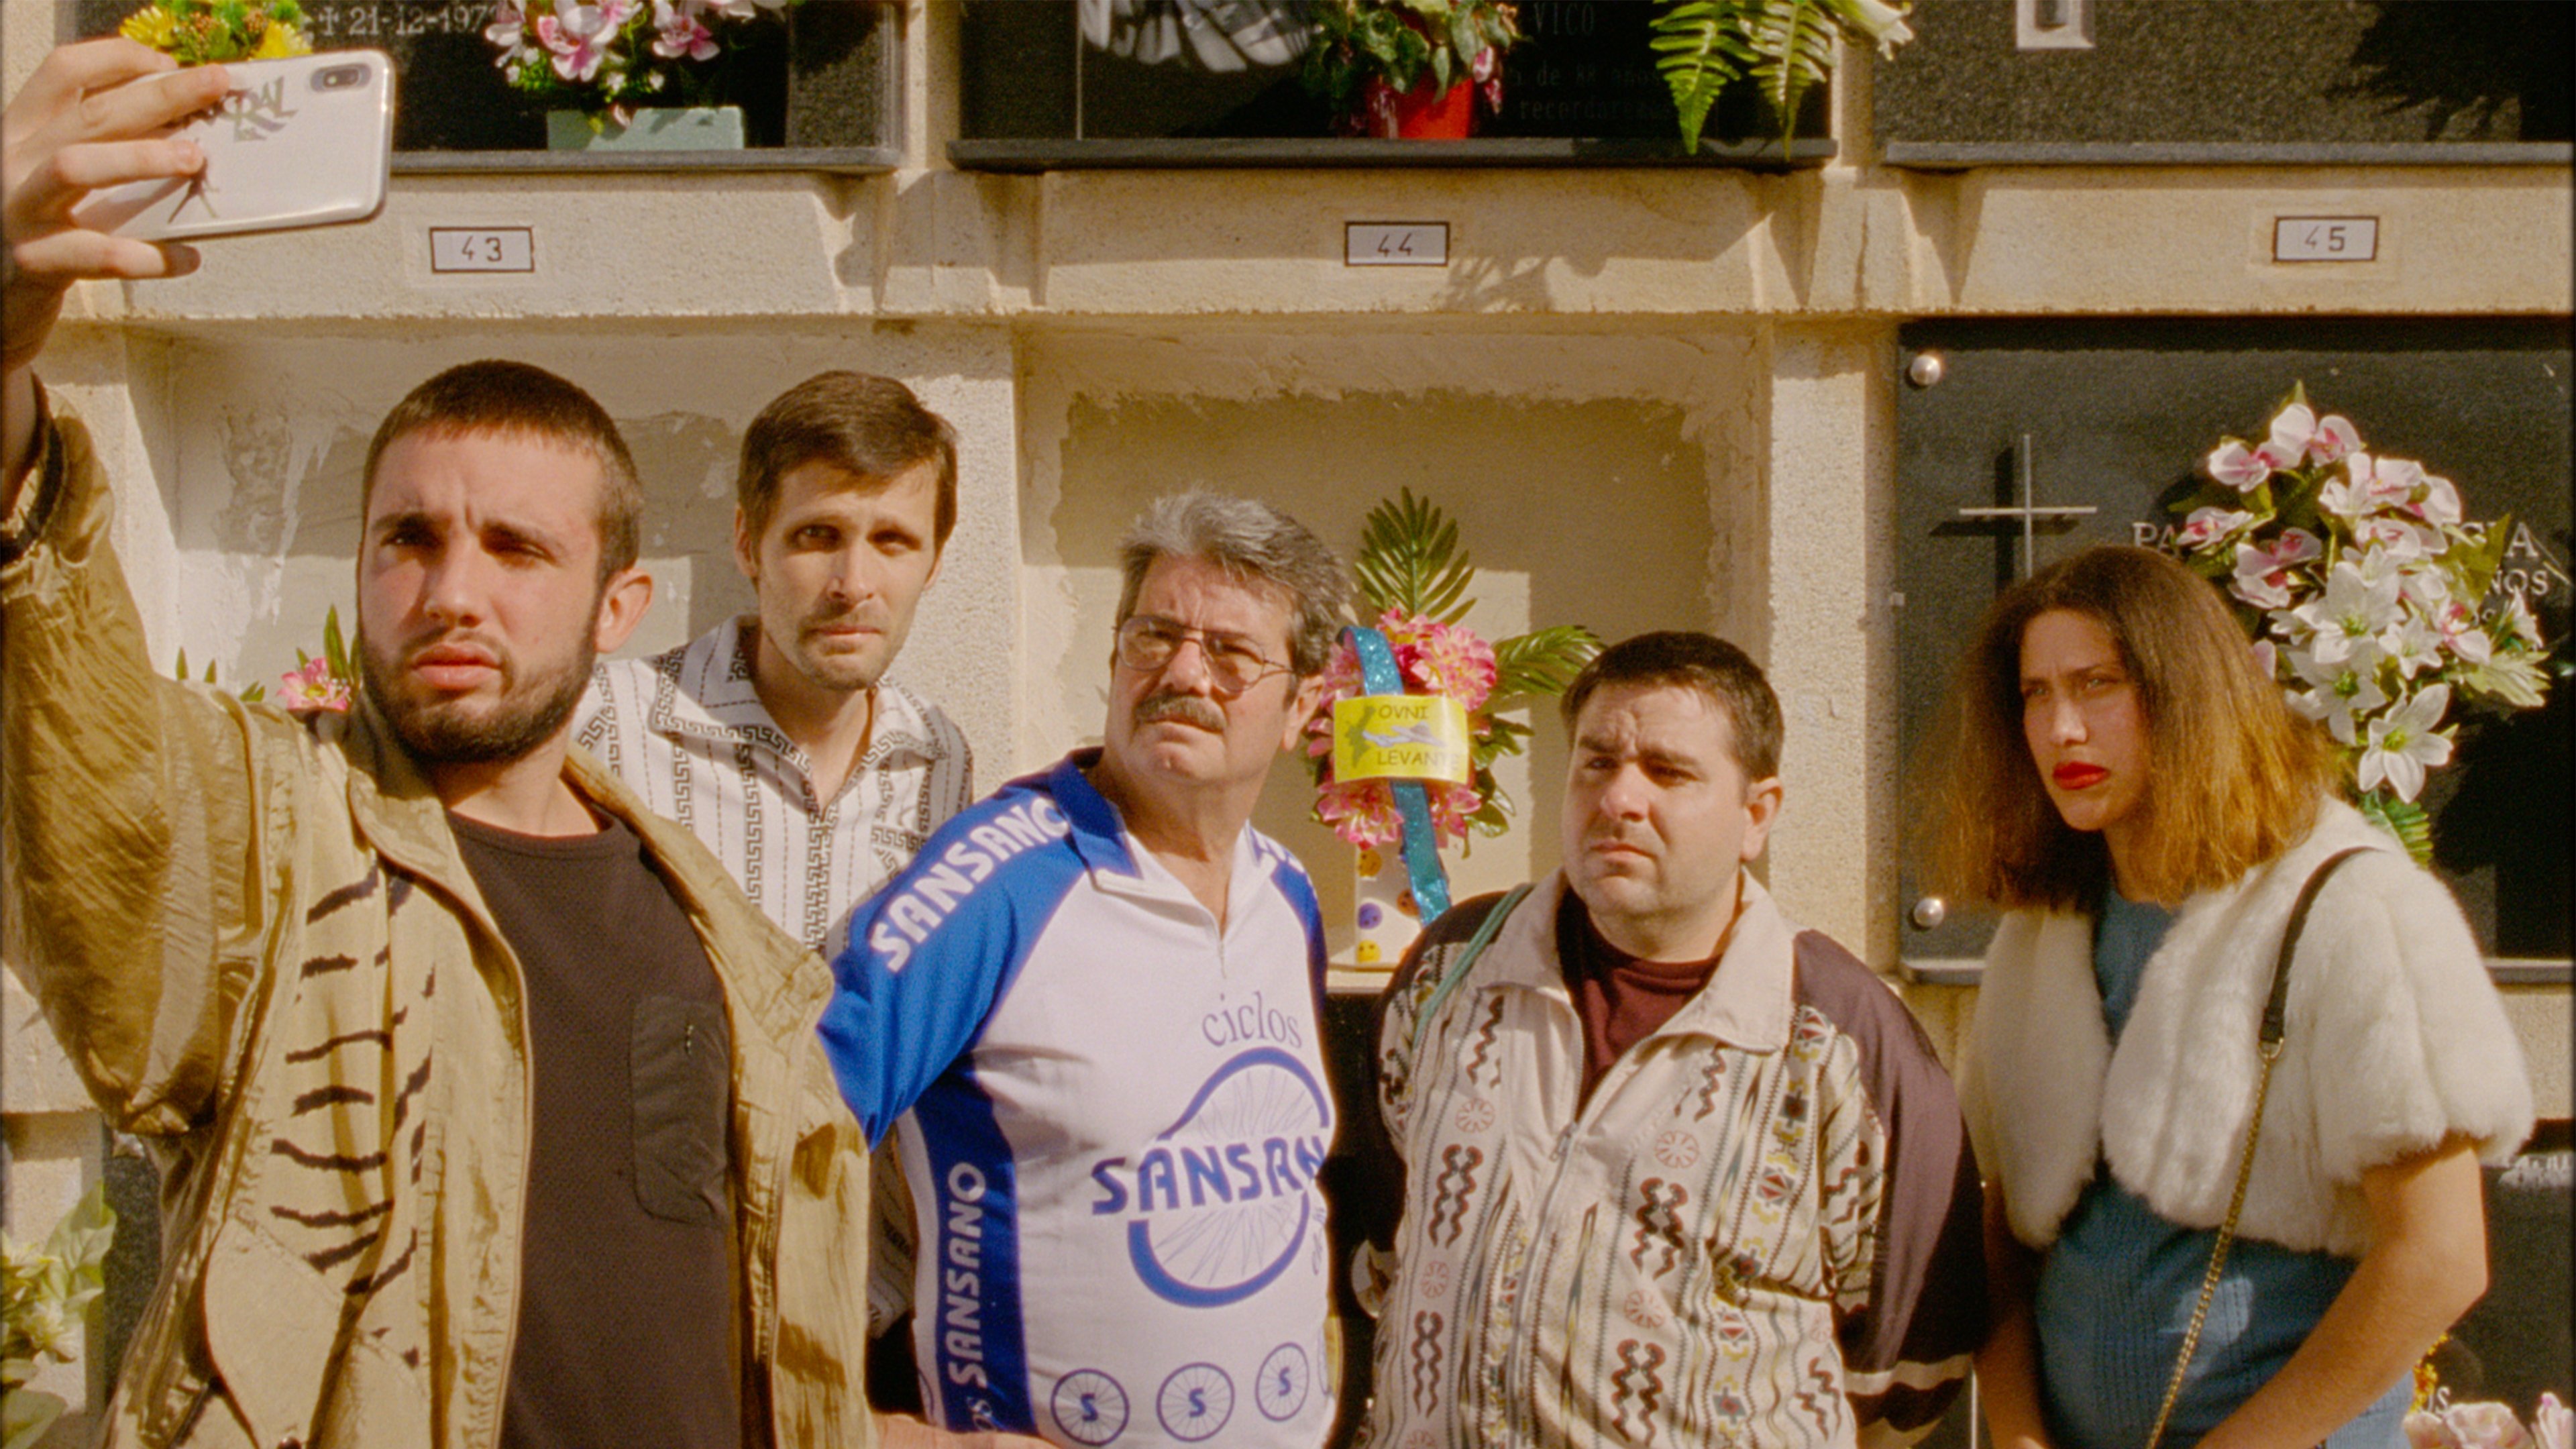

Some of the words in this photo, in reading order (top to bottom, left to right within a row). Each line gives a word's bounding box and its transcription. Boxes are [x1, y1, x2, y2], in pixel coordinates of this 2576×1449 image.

[348, 5, 496, 36] 21-12-197
[462, 235, 502, 262] 43
[1377, 232, 1413, 258] 44
[2304, 225, 2346, 252] 45
[1379, 704, 1429, 720] OVNI
[1201, 990, 1303, 1049] ciclos
[1091, 1135, 1326, 1215] SANSAN
[945, 1161, 987, 1389] SANSANO
[1278, 1367, 1292, 1397] S
[1080, 1393, 1098, 1422] S
[1188, 1388, 1207, 1417] S
